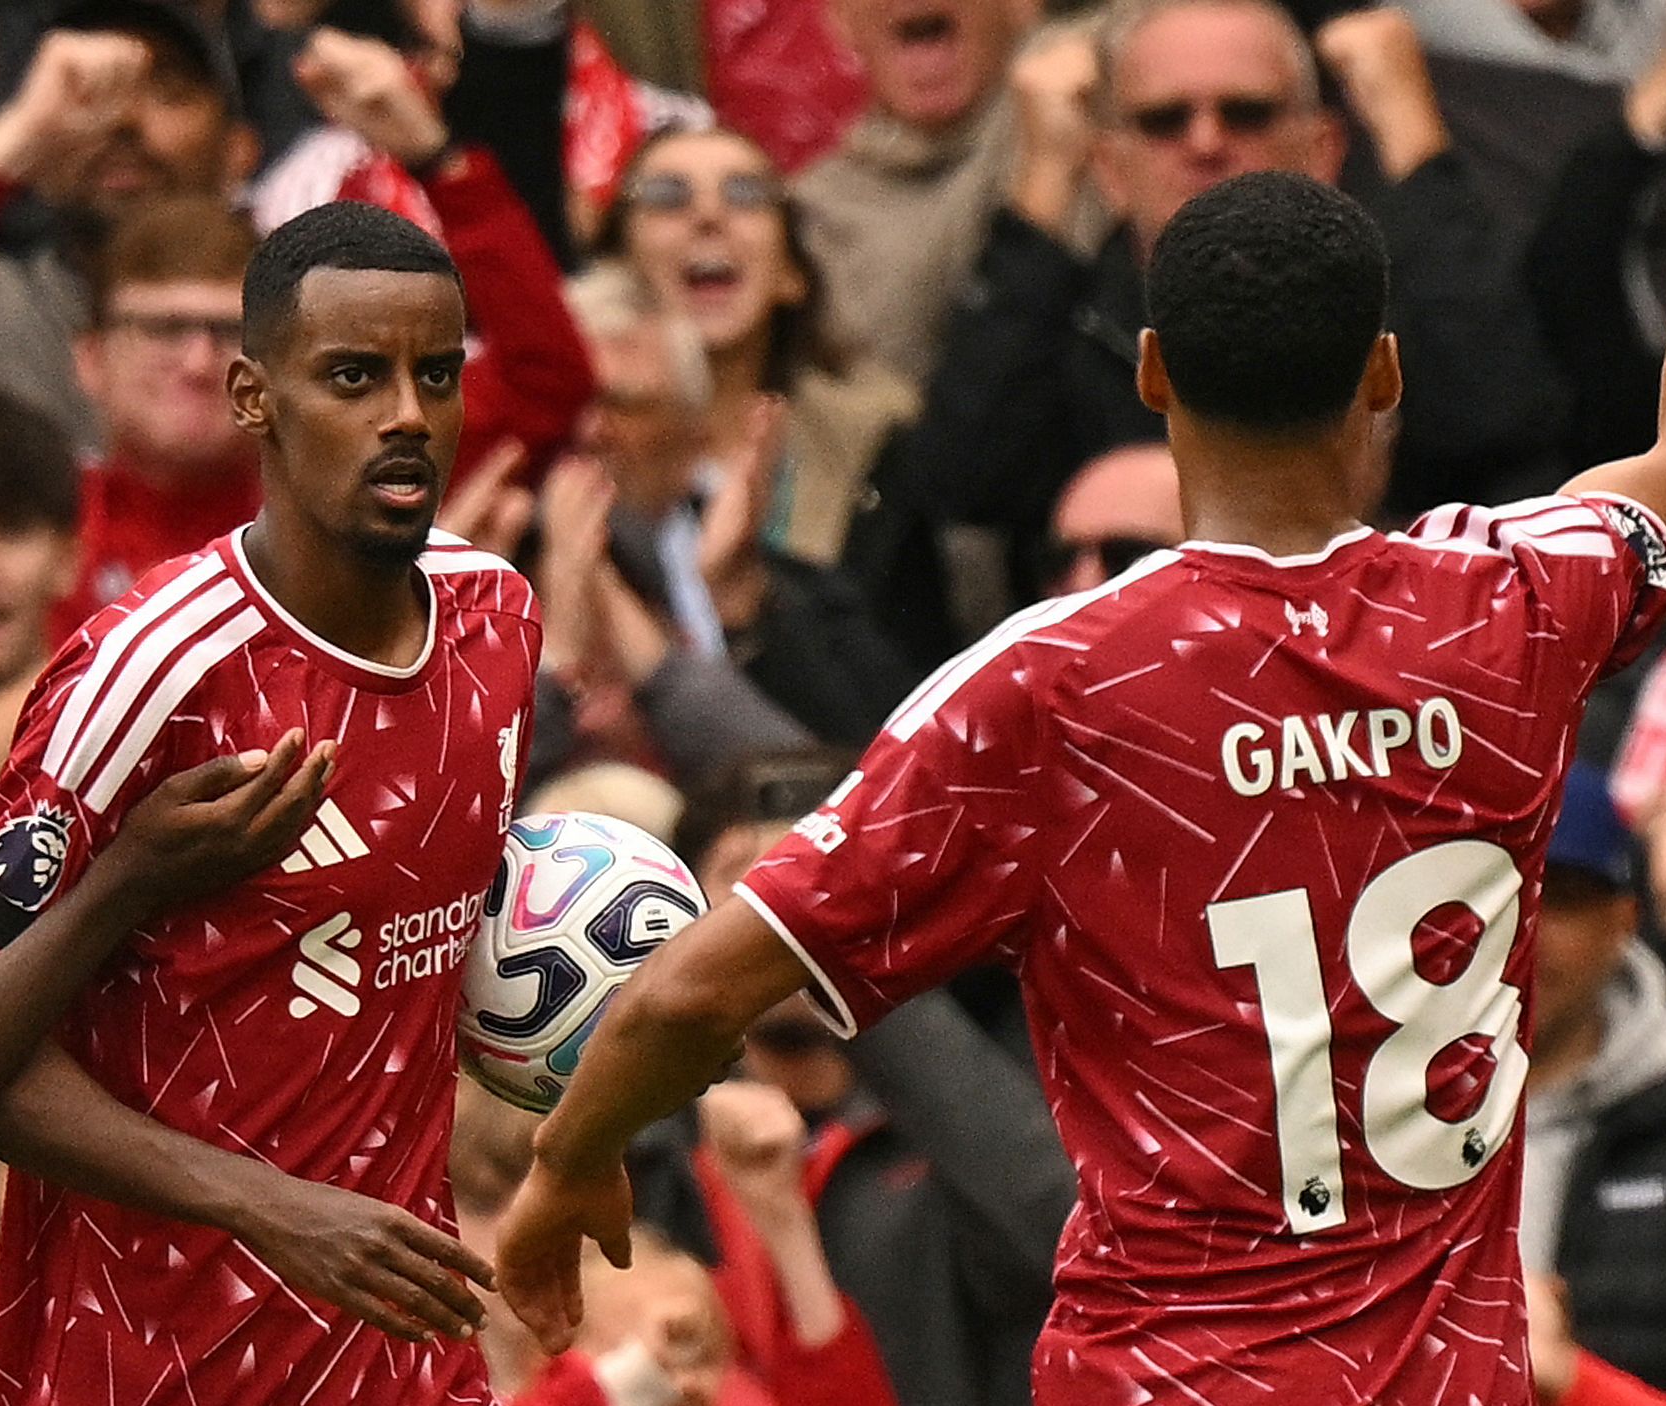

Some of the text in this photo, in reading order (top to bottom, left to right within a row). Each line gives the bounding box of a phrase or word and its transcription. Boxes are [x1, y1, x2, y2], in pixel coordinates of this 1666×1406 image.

[1222, 697, 1462, 797] GAKPO
[374, 924, 475, 989] chart
[378, 892, 481, 953] standa
[1206, 839, 1529, 1234] 18
